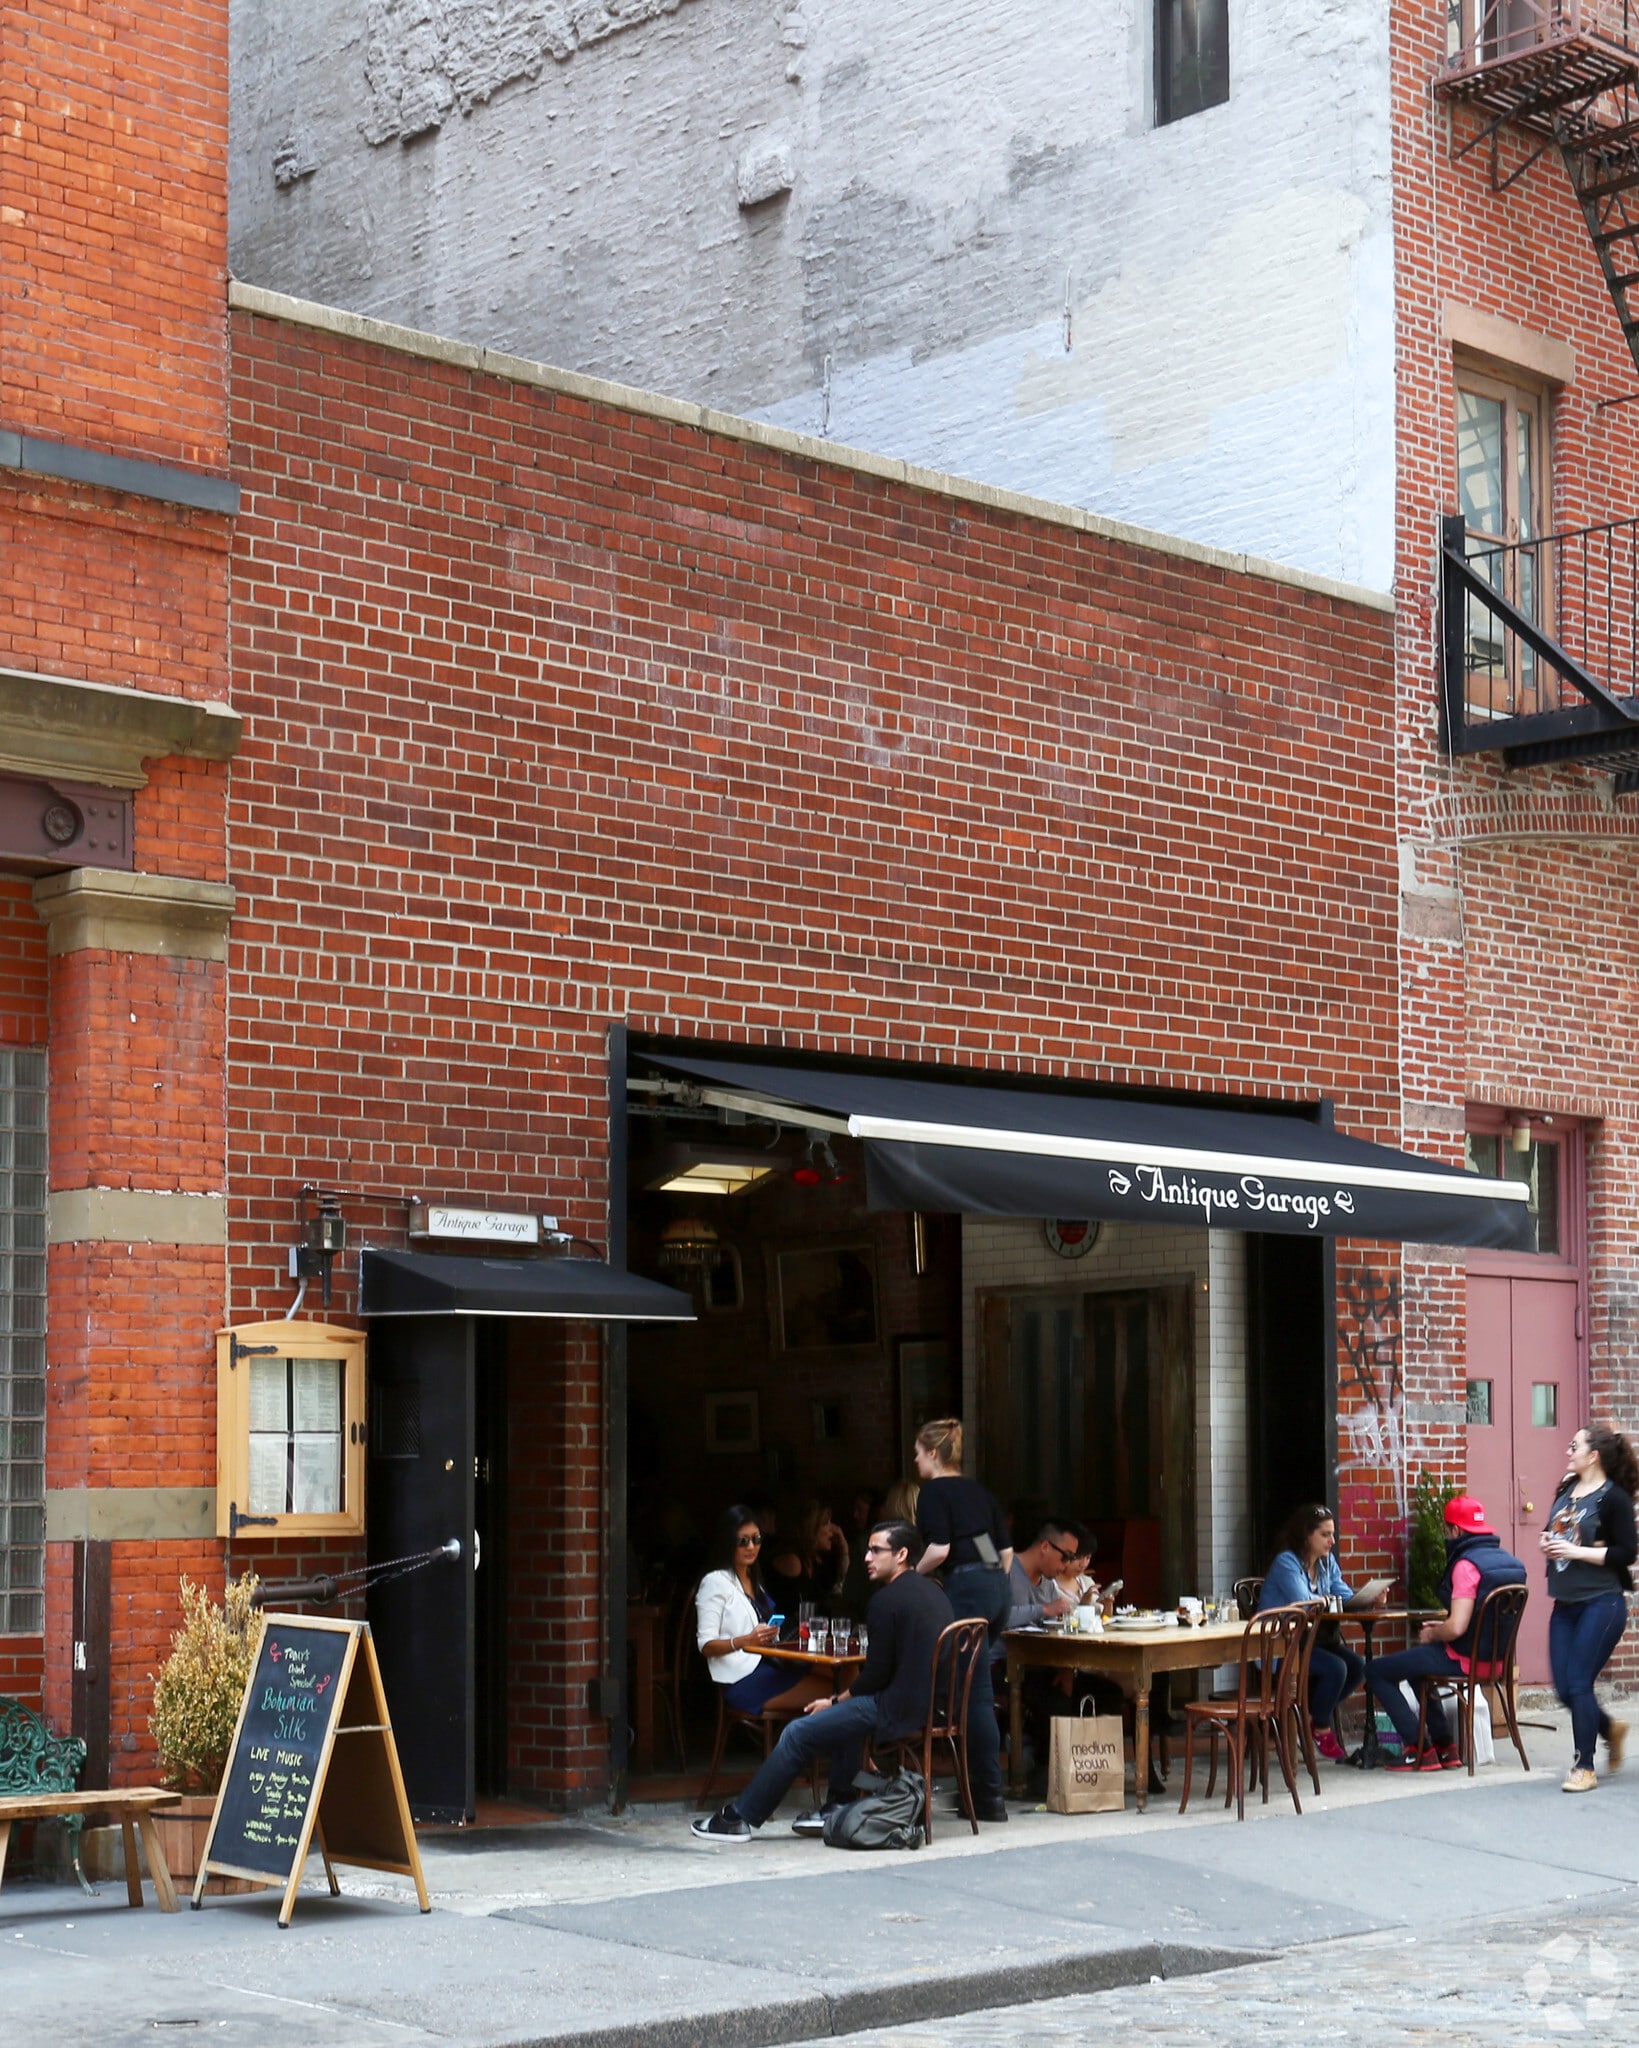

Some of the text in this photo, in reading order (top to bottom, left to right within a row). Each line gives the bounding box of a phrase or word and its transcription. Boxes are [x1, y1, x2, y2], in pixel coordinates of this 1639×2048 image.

[1135, 1164, 1331, 1229] Antique Garage
[432, 1210, 529, 1238] Antique Garage
[261, 1687, 317, 1712] Bohemian
[250, 1746, 303, 1767] LIVE MUSIC
[1071, 1741, 1116, 1755] medium
[1073, 1757, 1109, 1770] brown
[1075, 1772, 1098, 1787] bag
